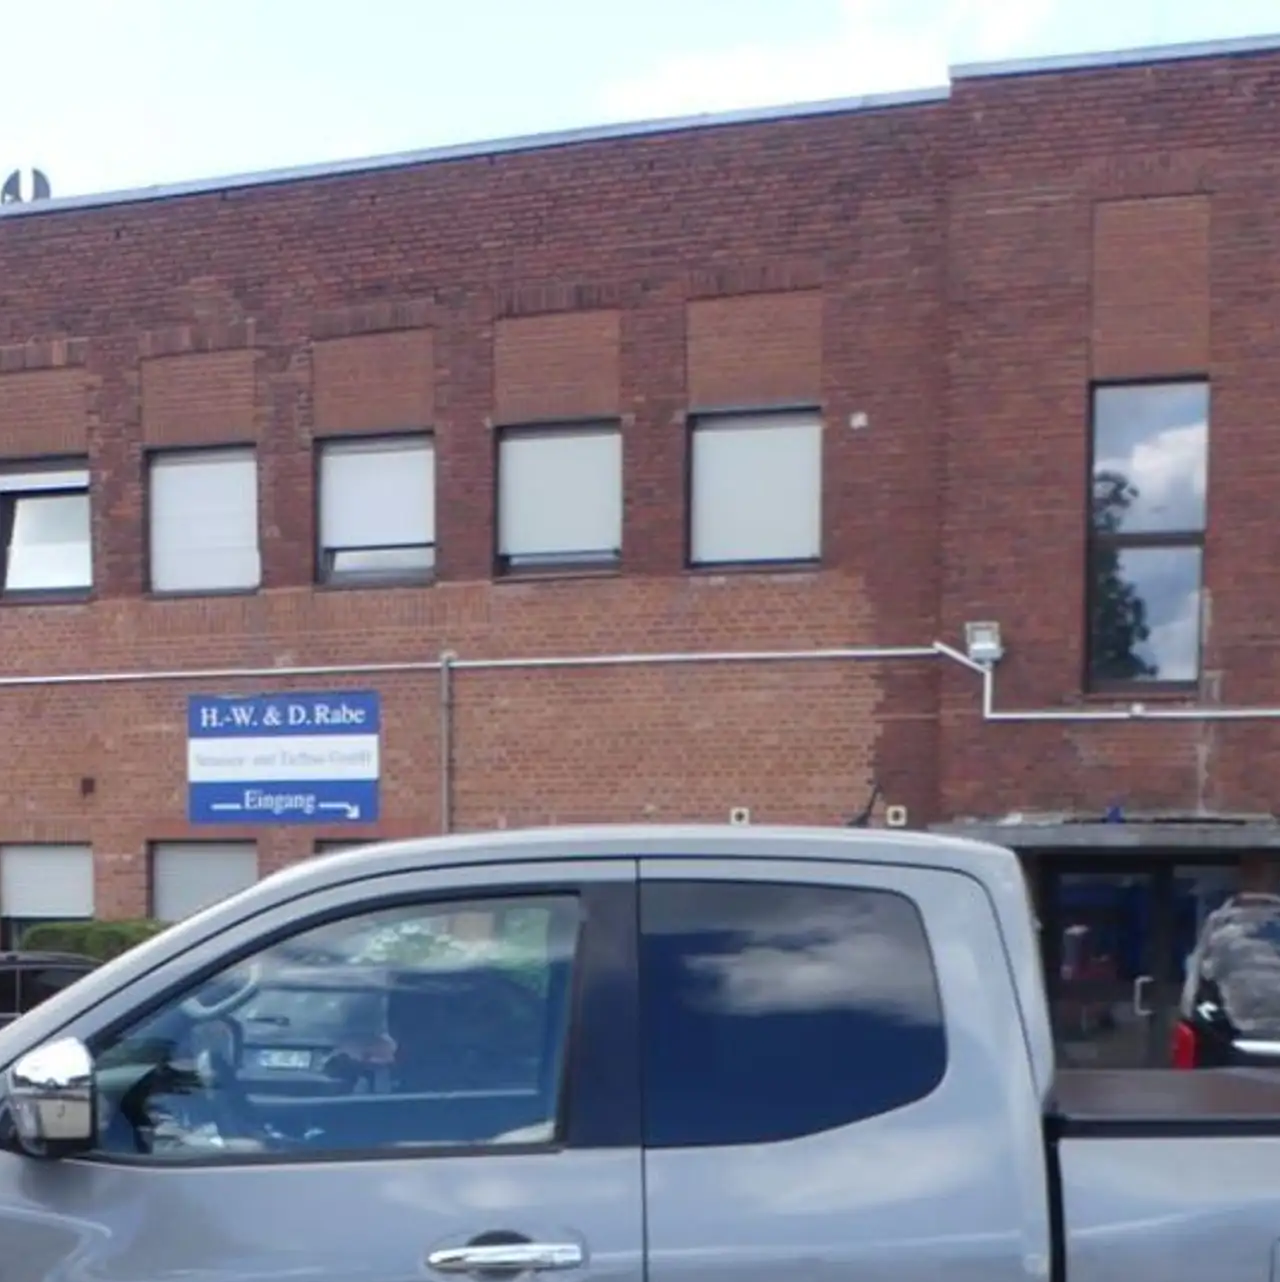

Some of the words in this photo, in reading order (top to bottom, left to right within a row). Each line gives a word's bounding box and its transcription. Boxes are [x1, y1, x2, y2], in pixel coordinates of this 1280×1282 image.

[200, 705, 259, 728] H.-W.
[262, 704, 283, 726] &
[243, 788, 317, 815] Eingang
